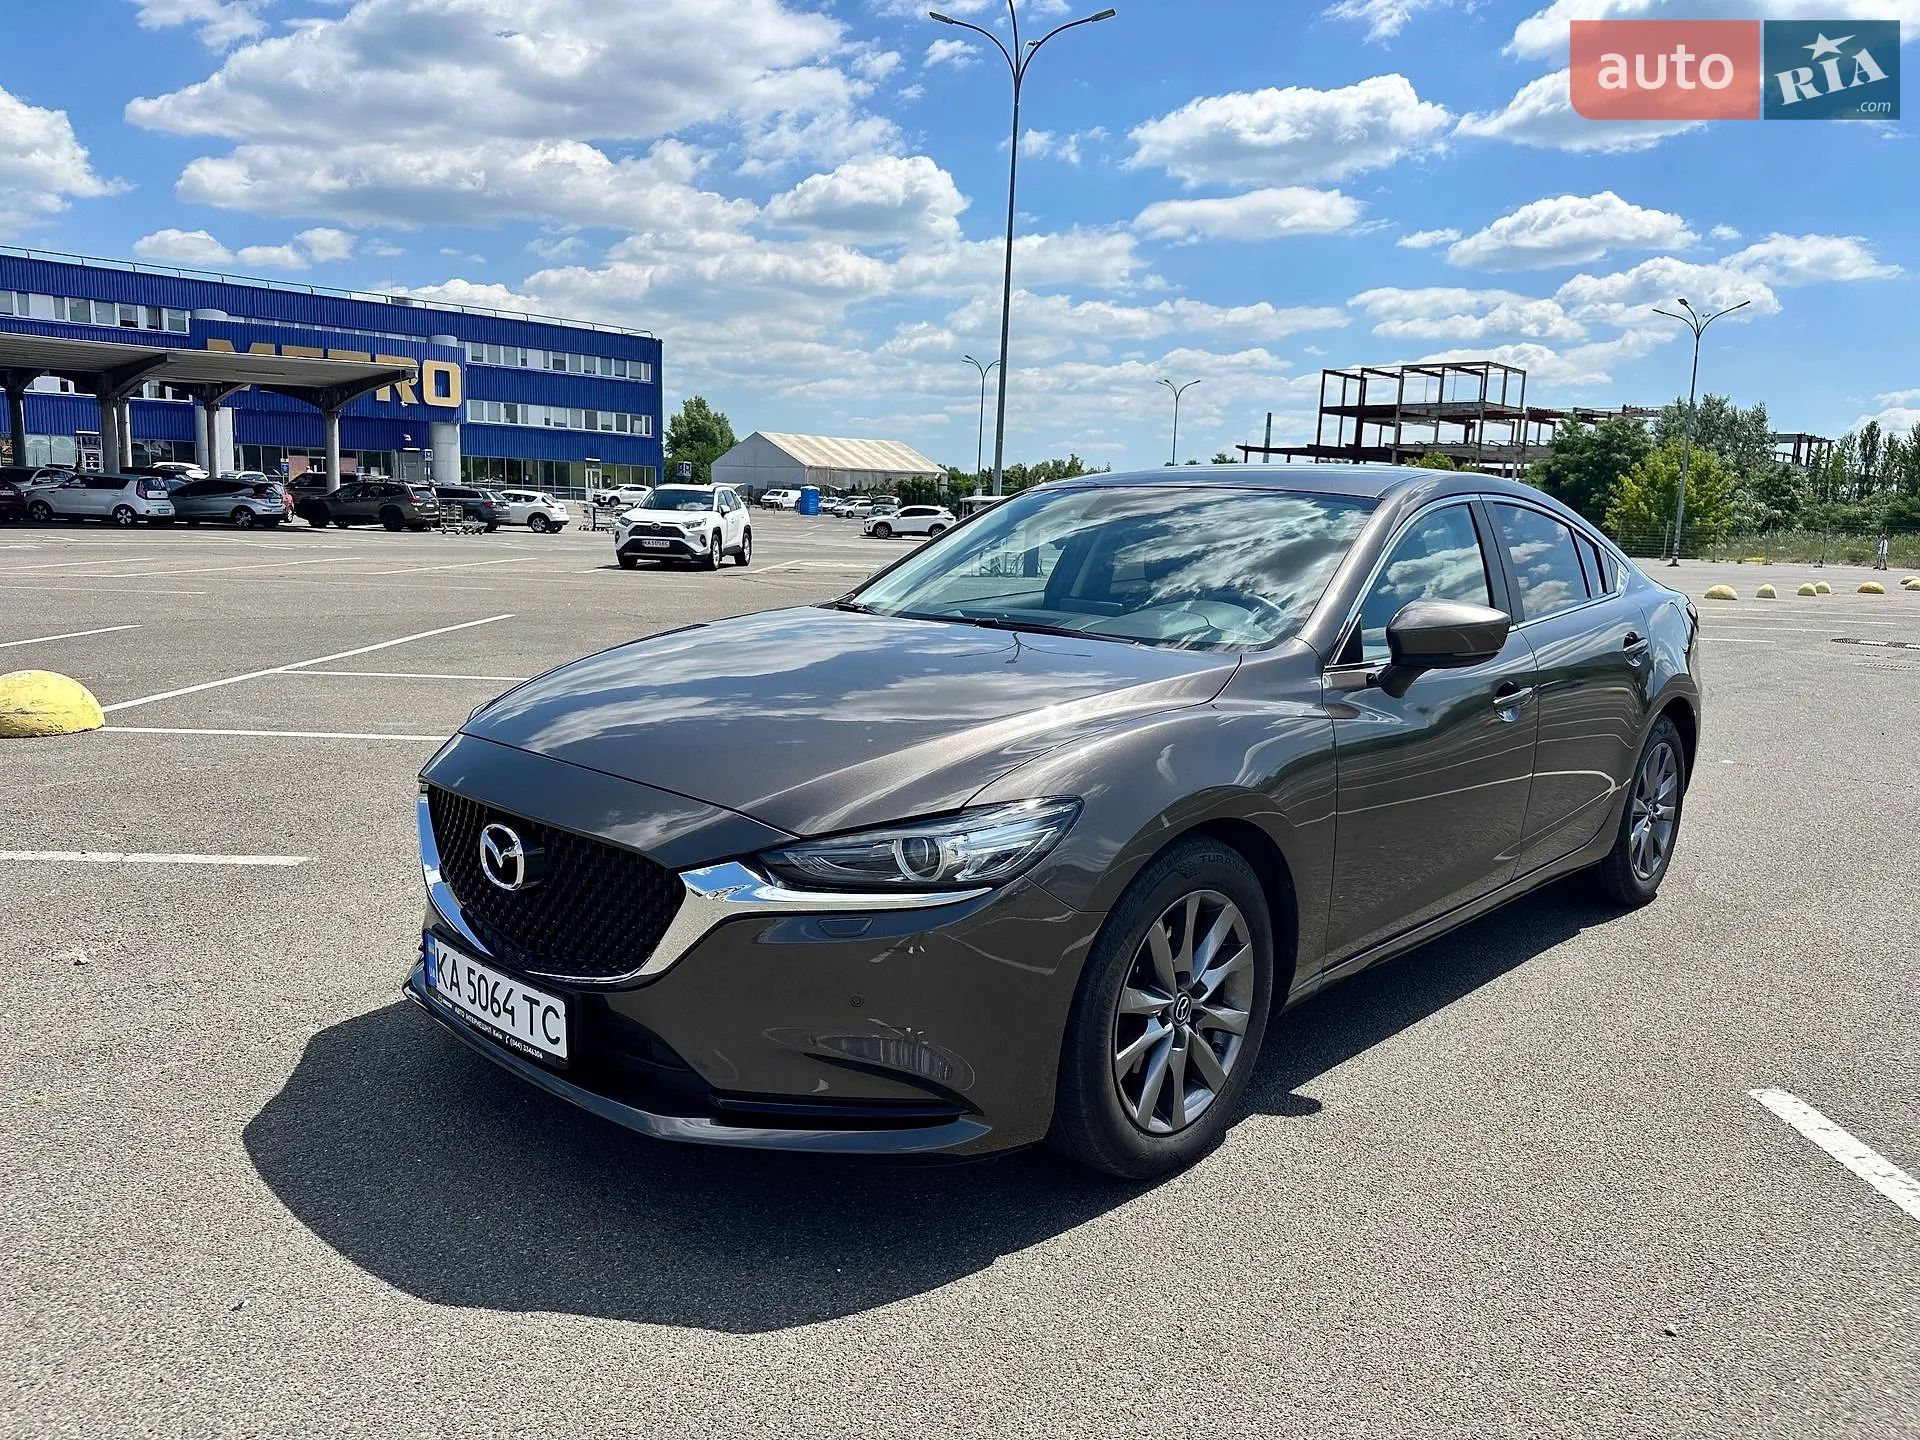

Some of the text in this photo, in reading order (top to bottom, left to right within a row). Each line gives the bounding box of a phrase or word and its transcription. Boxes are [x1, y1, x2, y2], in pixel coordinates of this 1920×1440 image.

[436, 947, 561, 1046] KA 5064 TC
